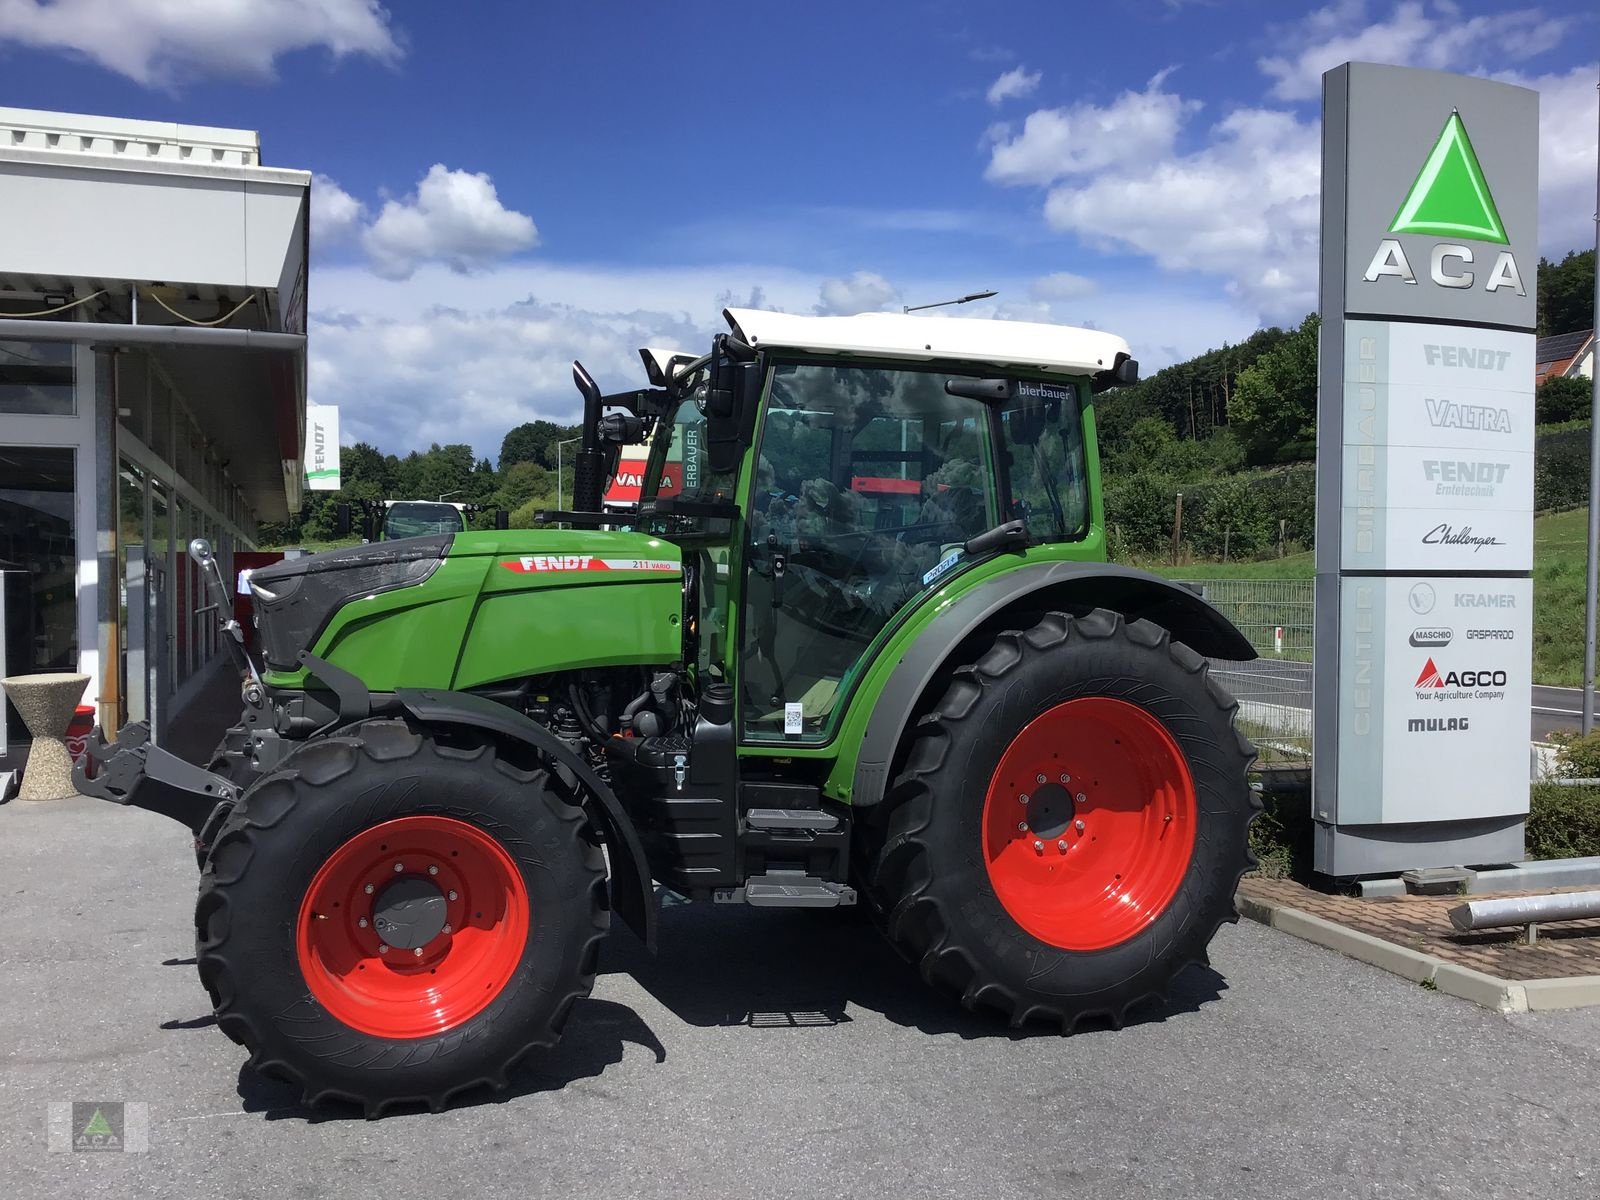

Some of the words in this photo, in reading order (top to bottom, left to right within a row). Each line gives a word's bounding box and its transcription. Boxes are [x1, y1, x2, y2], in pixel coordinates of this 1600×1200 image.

[1362, 238, 1527, 297] ACA
[1423, 344, 1511, 371] FENDT
[1018, 380, 1070, 400] bierbauer
[1424, 398, 1512, 434] VALTRA
[315, 422, 325, 472] FENDT
[1356, 336, 1376, 553] BIERBAUER
[686, 430, 697, 488] ERBAUER
[615, 473, 673, 488] VALA
[1422, 460, 1510, 483] FENDT
[1435, 483, 1495, 497] Erntetechnik
[1421, 523, 1506, 553] Challenger
[519, 555, 593, 571] FENDT
[632, 560, 649, 569] 211
[651, 562, 671, 570] VARIO
[1454, 593, 1516, 609] KRAMER
[1415, 631, 1452, 639] MASCHIO
[1466, 629, 1514, 640] GASPARDO
[1354, 585, 1372, 737] CENTER
[1444, 670, 1507, 687] AGCO
[1415, 691, 1432, 700] Your
[1433, 690, 1473, 701] Agriculture
[1474, 690, 1505, 700] Company
